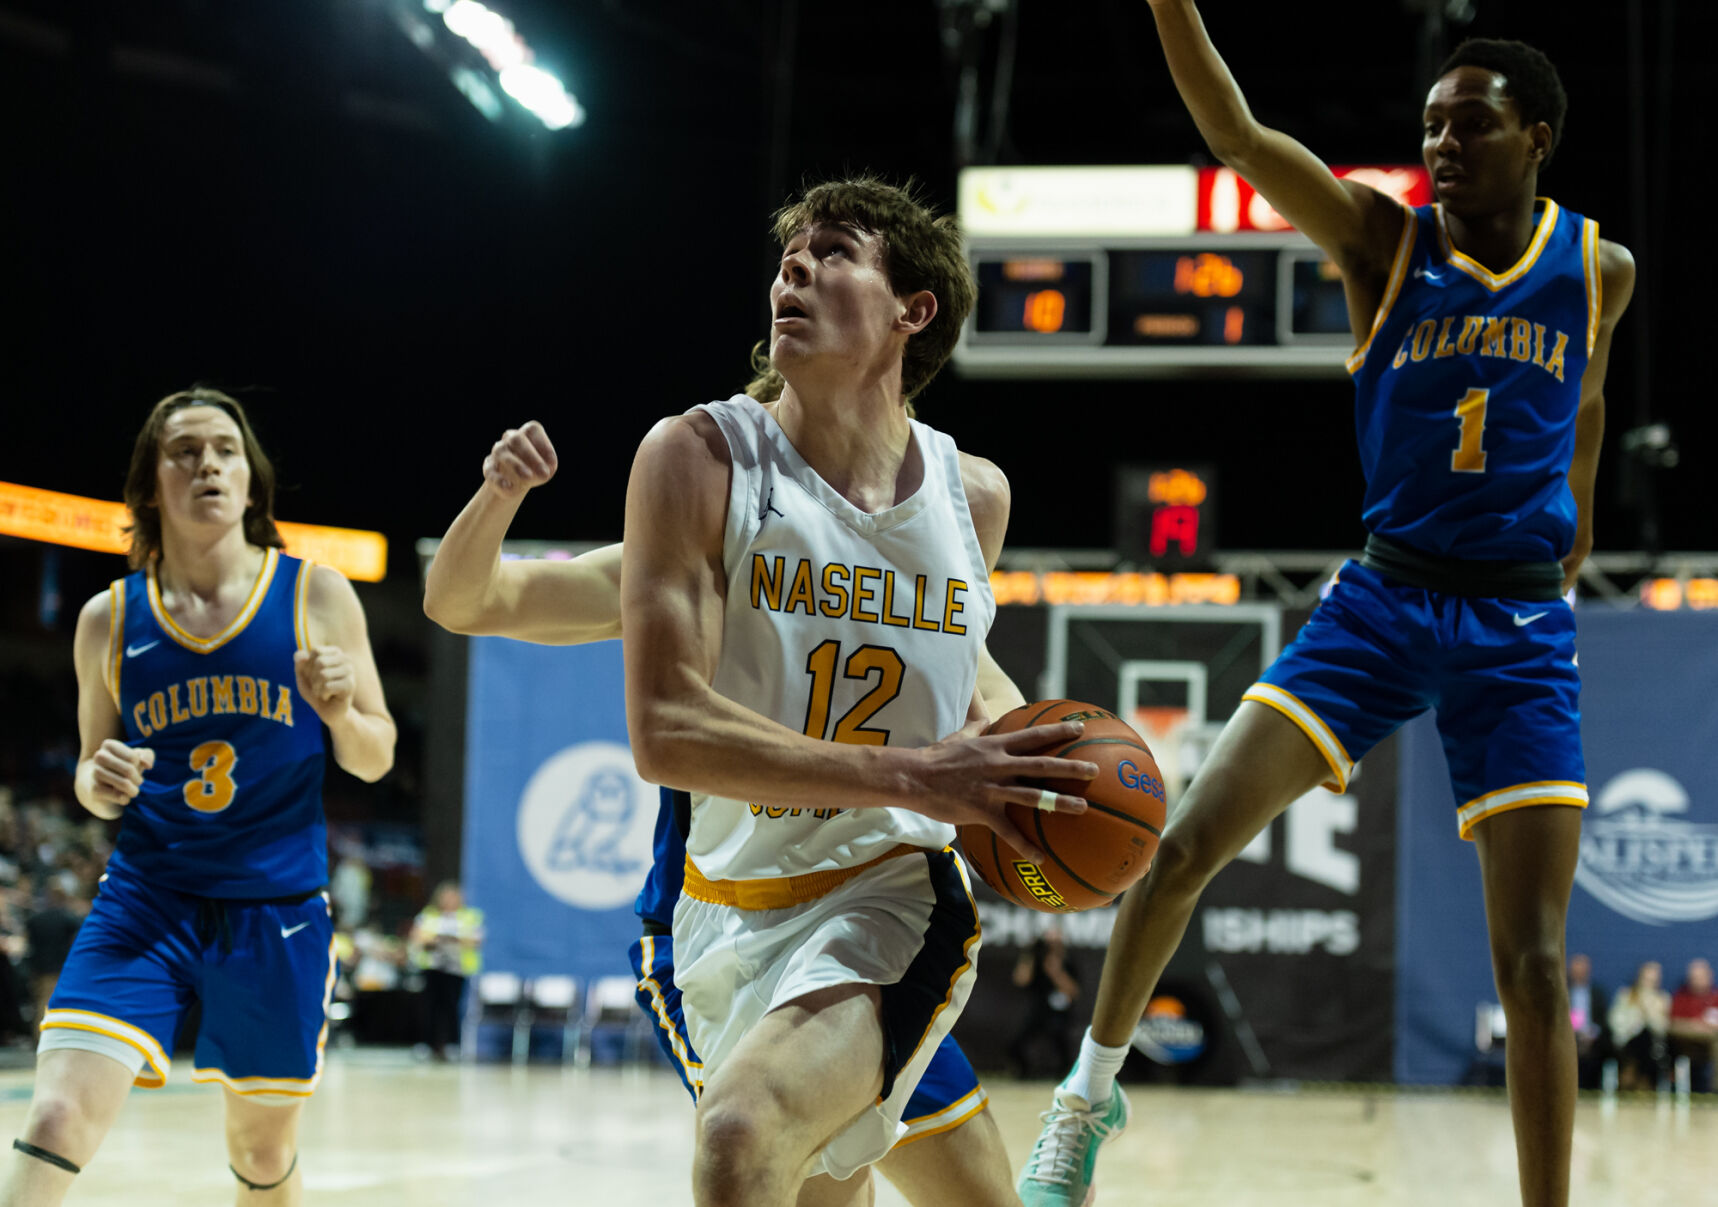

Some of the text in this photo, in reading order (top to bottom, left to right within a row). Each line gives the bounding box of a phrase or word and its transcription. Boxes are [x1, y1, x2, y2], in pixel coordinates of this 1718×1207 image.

[1392, 315, 1569, 383] COLUMBIA
[1450, 387, 1490, 473] 1
[750, 553, 969, 636] NASELLE
[133, 675, 295, 738] COLUMBIA
[803, 638, 907, 747] 12
[182, 740, 239, 814] 3
[1117, 759, 1165, 803] Gesa
